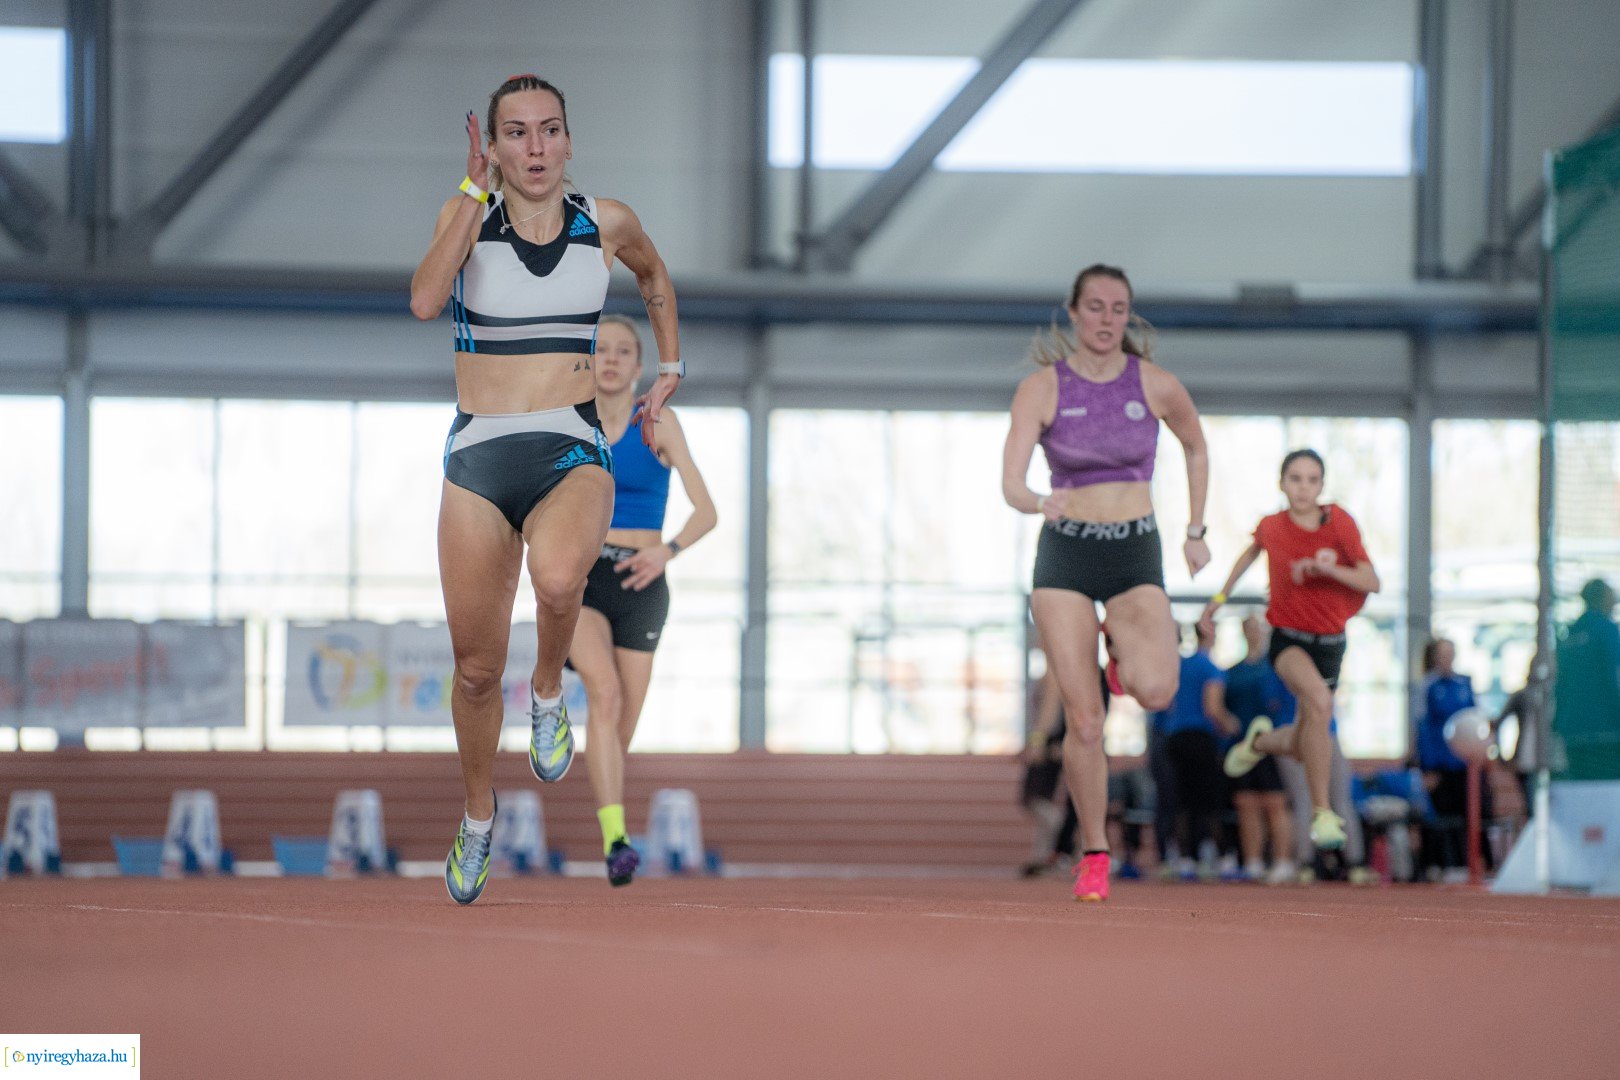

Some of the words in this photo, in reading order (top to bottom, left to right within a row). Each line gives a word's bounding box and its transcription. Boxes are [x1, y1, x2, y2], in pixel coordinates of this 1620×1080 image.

[569, 225, 596, 237] adidas
[554, 455, 594, 470] adidas
[1081, 521, 1130, 540] PRO
